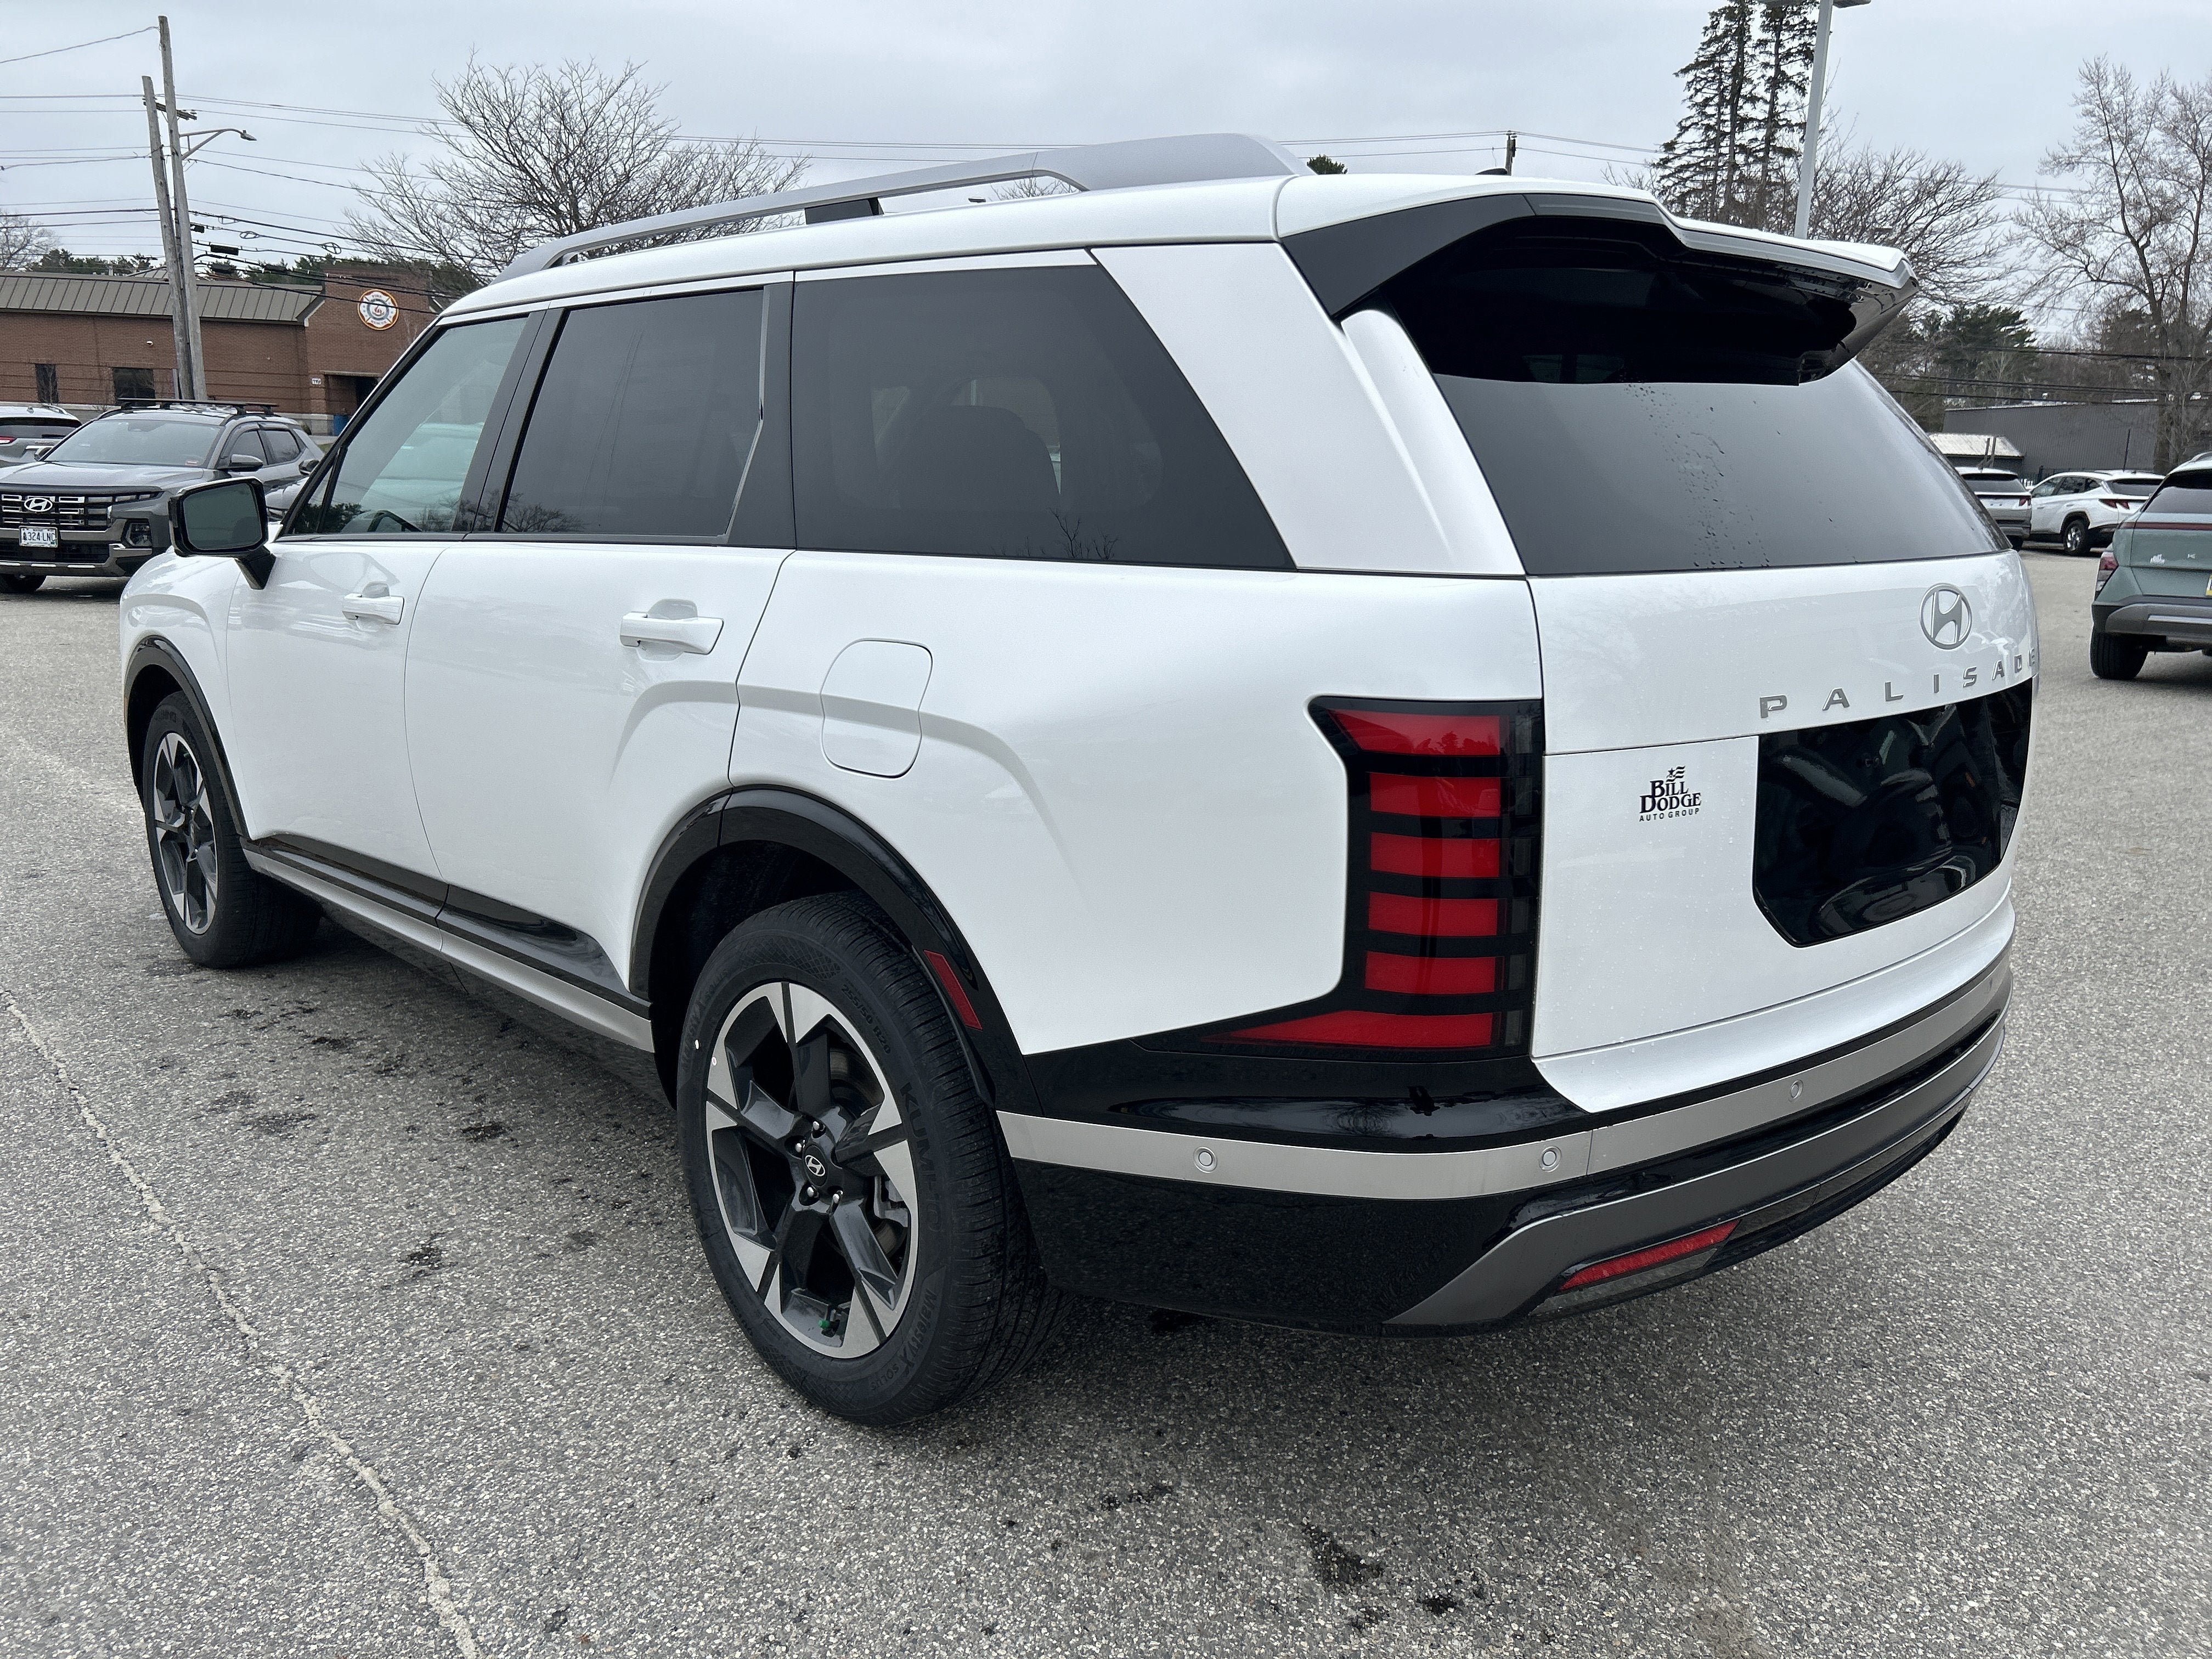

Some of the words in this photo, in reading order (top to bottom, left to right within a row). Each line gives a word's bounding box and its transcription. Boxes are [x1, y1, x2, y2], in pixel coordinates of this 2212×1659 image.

[1759, 648, 2035, 718] PALISADE
[1639, 793, 1702, 814] DODGE
[1650, 780, 1689, 798] BILL
[1639, 813, 1664, 822] AUTO
[1668, 808, 1700, 818] GROUP
[841, 984, 873, 1024] 255/50
[873, 1025, 891, 1054] R20
[900, 1082, 943, 1232] KUMHO
